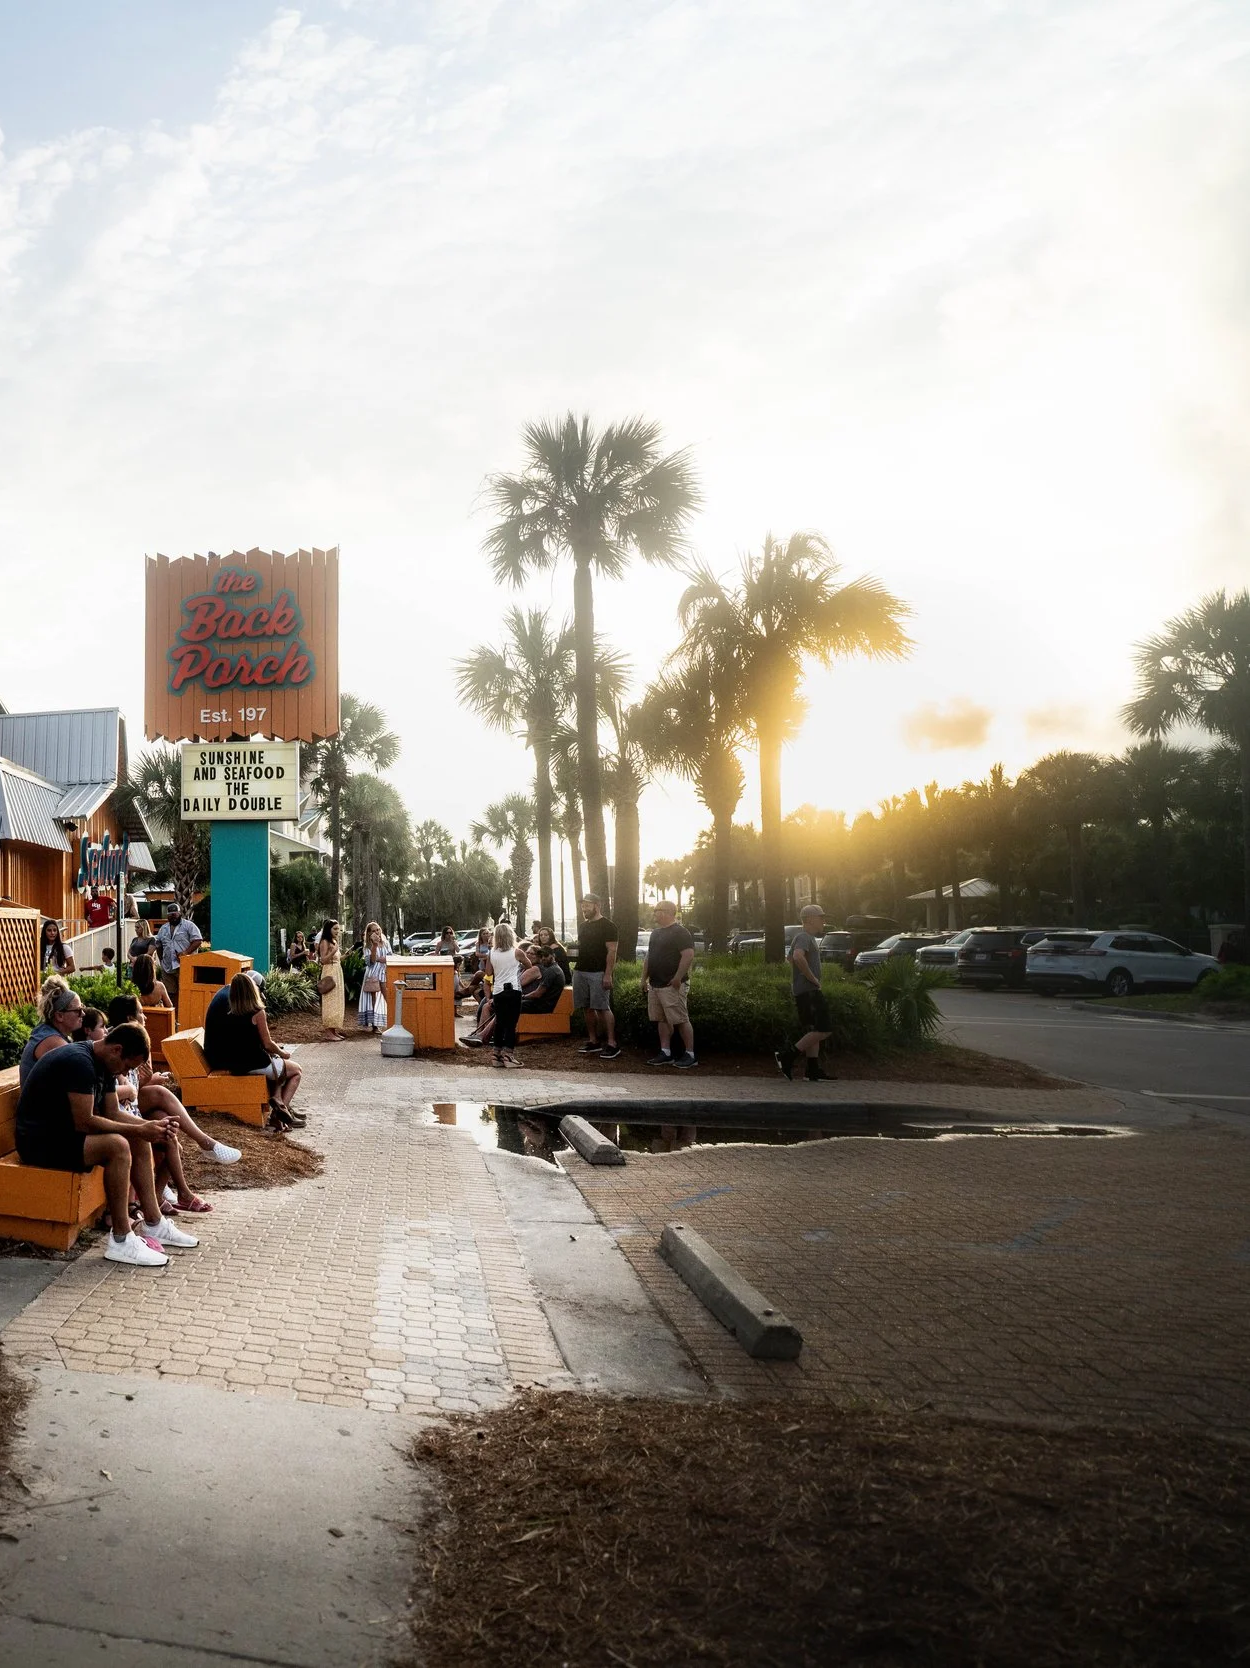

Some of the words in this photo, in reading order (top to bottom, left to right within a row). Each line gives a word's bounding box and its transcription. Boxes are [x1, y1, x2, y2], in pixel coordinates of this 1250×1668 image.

[216, 570, 256, 594] the
[180, 593, 299, 642] Back
[170, 641, 312, 690] Porch
[200, 709, 232, 723] Est.
[238, 707, 267, 721] 197
[200, 751, 265, 765] SUNSHINE
[193, 767, 218, 781] AND
[224, 766, 285, 780] SEAFOOD
[225, 782, 250, 796] THE
[183, 797, 221, 812] DAILY
[228, 796, 282, 811] DOUBLE
